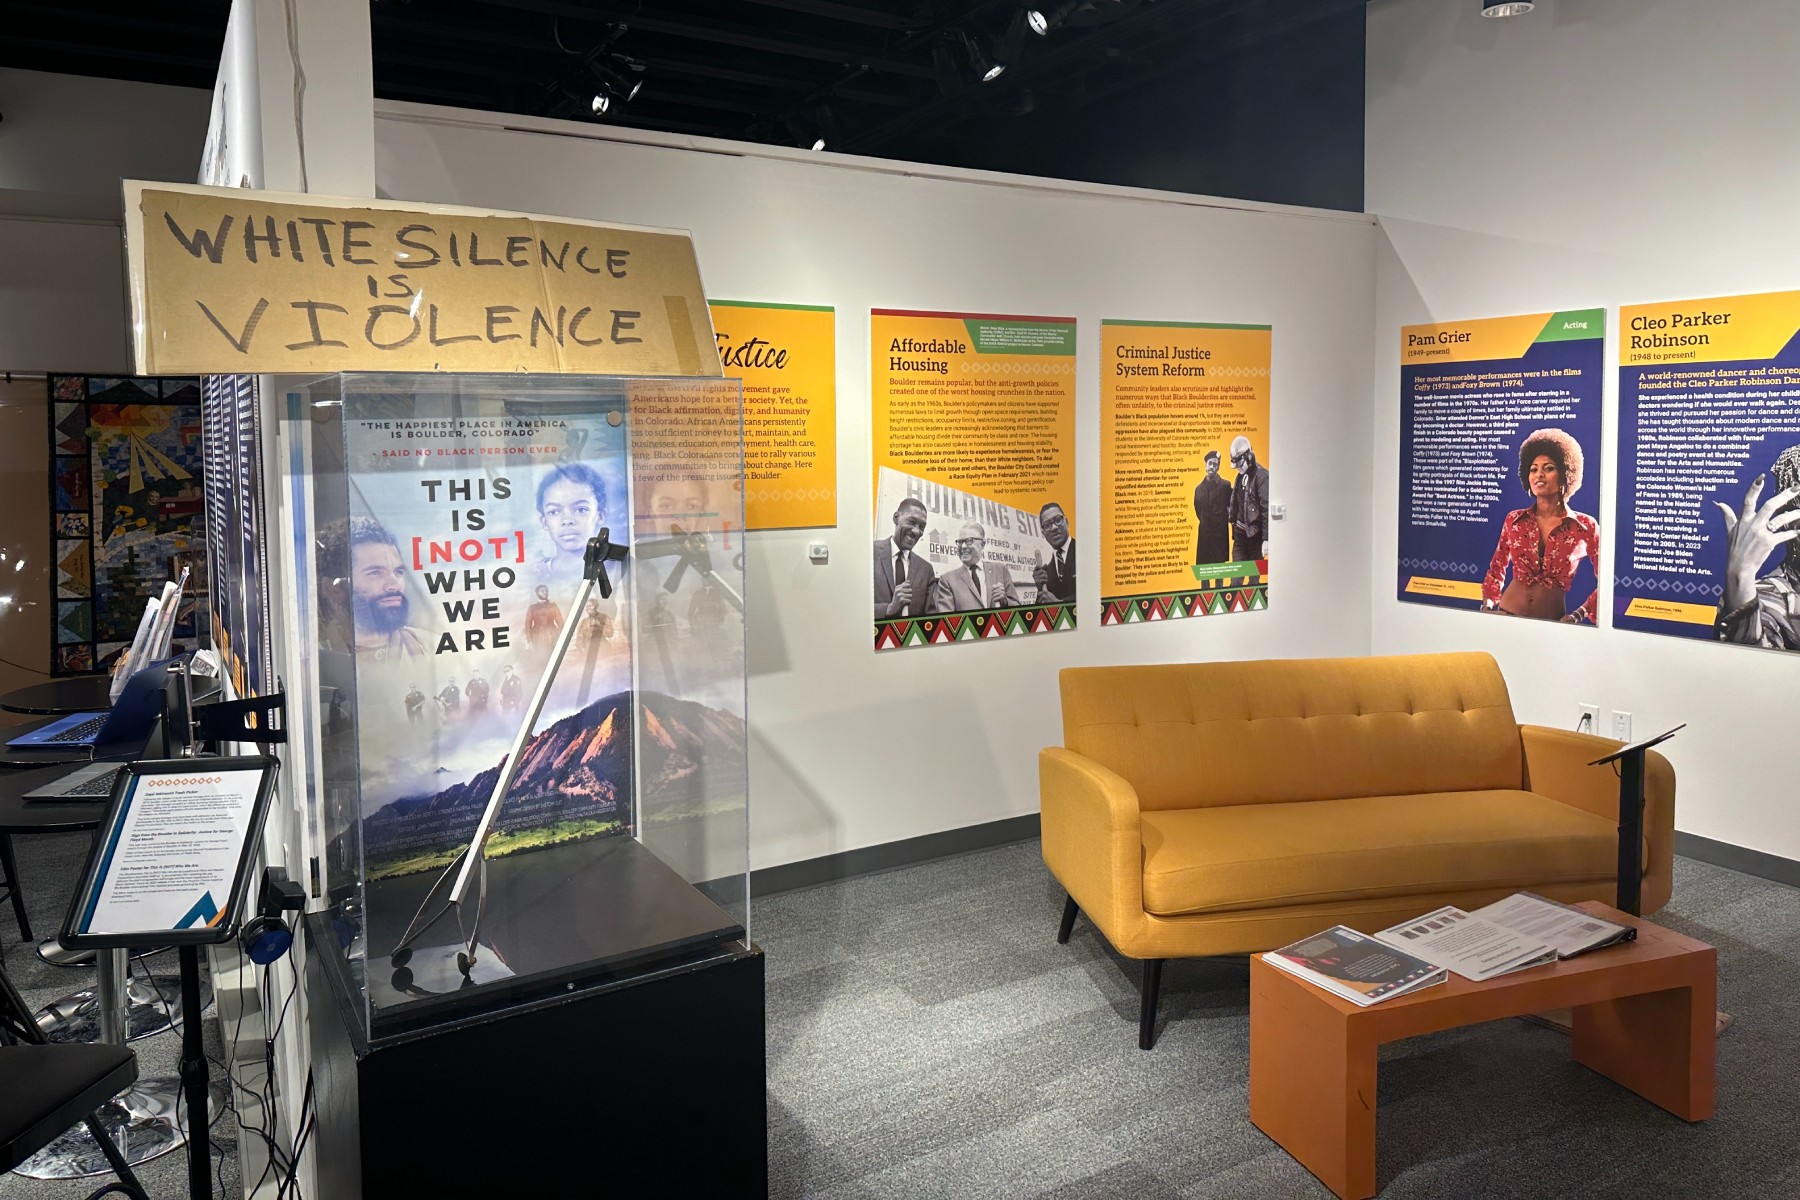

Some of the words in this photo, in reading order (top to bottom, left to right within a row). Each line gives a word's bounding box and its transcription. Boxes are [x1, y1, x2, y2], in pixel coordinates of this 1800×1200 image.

[165, 212, 376, 267] WHITE
[395, 224, 631, 279] SILENCE
[368, 274, 416, 298] IS
[195, 298, 644, 354] VIOLENCE
[1563, 321, 1588, 330] Acting
[1631, 317, 1667, 331] Cleo
[1672, 312, 1731, 328] Parker
[1408, 334, 1436, 346] Pam
[1439, 331, 1471, 343] Grier
[1631, 334, 1709, 349] Robinson
[890, 338, 966, 354] Affordable
[1116, 345, 1169, 359] Criminal
[1172, 346, 1211, 360] Justice
[1630, 353, 1651, 362] (1948
[1663, 351, 1696, 361] present)
[890, 357, 948, 375] Housing
[1116, 363, 1159, 378] System
[1162, 363, 1205, 377] Reform
[1442, 373, 1477, 381] memorable
[1478, 371, 1522, 381] performances
[1523, 371, 1540, 379] were
[1639, 373, 1646, 381] A
[1648, 371, 1715, 380] world-renowned
[1717, 369, 1747, 378] dancer
[1749, 368, 1767, 376] and
[890, 378, 916, 386] Boulder
[946, 379, 973, 387] popular,
[987, 379, 997, 387] the
[998, 380, 1035, 388] anti-growth
[1036, 380, 1059, 388] policies
[1115, 385, 1148, 393] Community
[1414, 384, 1431, 392] Coffy
[1432, 383, 1451, 391] (1973)
[1502, 380, 1524, 388] (1974).
[1638, 381, 1672, 390] founded
[1673, 380, 1687, 388] the
[1689, 379, 1707, 388] Cleo
[1709, 378, 1738, 387] Parker
[1740, 377, 1782, 386] Robinson
[971, 388, 995, 396] housing
[1229, 393, 1256, 401] connected,
[681, 395, 701, 404] hope
[703, 395, 714, 403] for
[723, 395, 746, 404] bettr
[749, 396, 778, 405] society.
[779, 396, 794, 405] Yet,
[1132, 402, 1156, 410] unfairly,
[634, 406, 647, 414] for
[649, 406, 672, 414] Black
[674, 406, 722, 415] affirmation,
[724, 407, 755, 416] digity,
[757, 407, 771, 415] and
[773, 407, 811, 416] humanity
[395, 421, 456, 429] HAPPIEST
[459, 421, 497, 429] PLACE
[501, 420, 513, 428] IN
[516, 420, 566, 428] AMERICA
[687, 418, 717, 426] African
[763, 418, 806, 427] persistently
[391, 431, 402, 439] IS
[407, 430, 467, 439] BOULDER,
[755, 429, 791, 437] maintain,
[774, 439, 798, 447] health
[382, 449, 411, 458] SAID
[415, 448, 432, 456] NO
[437, 447, 475, 456] BLACK
[480, 447, 525, 455] PERSON
[529, 446, 558, 454] EVER
[770, 450, 787, 458] rally
[765, 461, 793, 469] change.
[421, 477, 512, 502] THIS
[451, 508, 486, 531] IS
[1016, 509, 1045, 539] SIT
[986, 538, 1010, 549] FFERED
[412, 530, 525, 571] [NOT]
[929, 543, 959, 556] DENVER
[988, 551, 1016, 563] RENEWAL
[1017, 557, 1037, 566] AUTHOR
[1659, 565, 1677, 573] Medal
[1697, 568, 1713, 576] Arts.
[424, 566, 516, 595] WHO
[443, 597, 501, 623] WE
[435, 626, 510, 655] ARE
